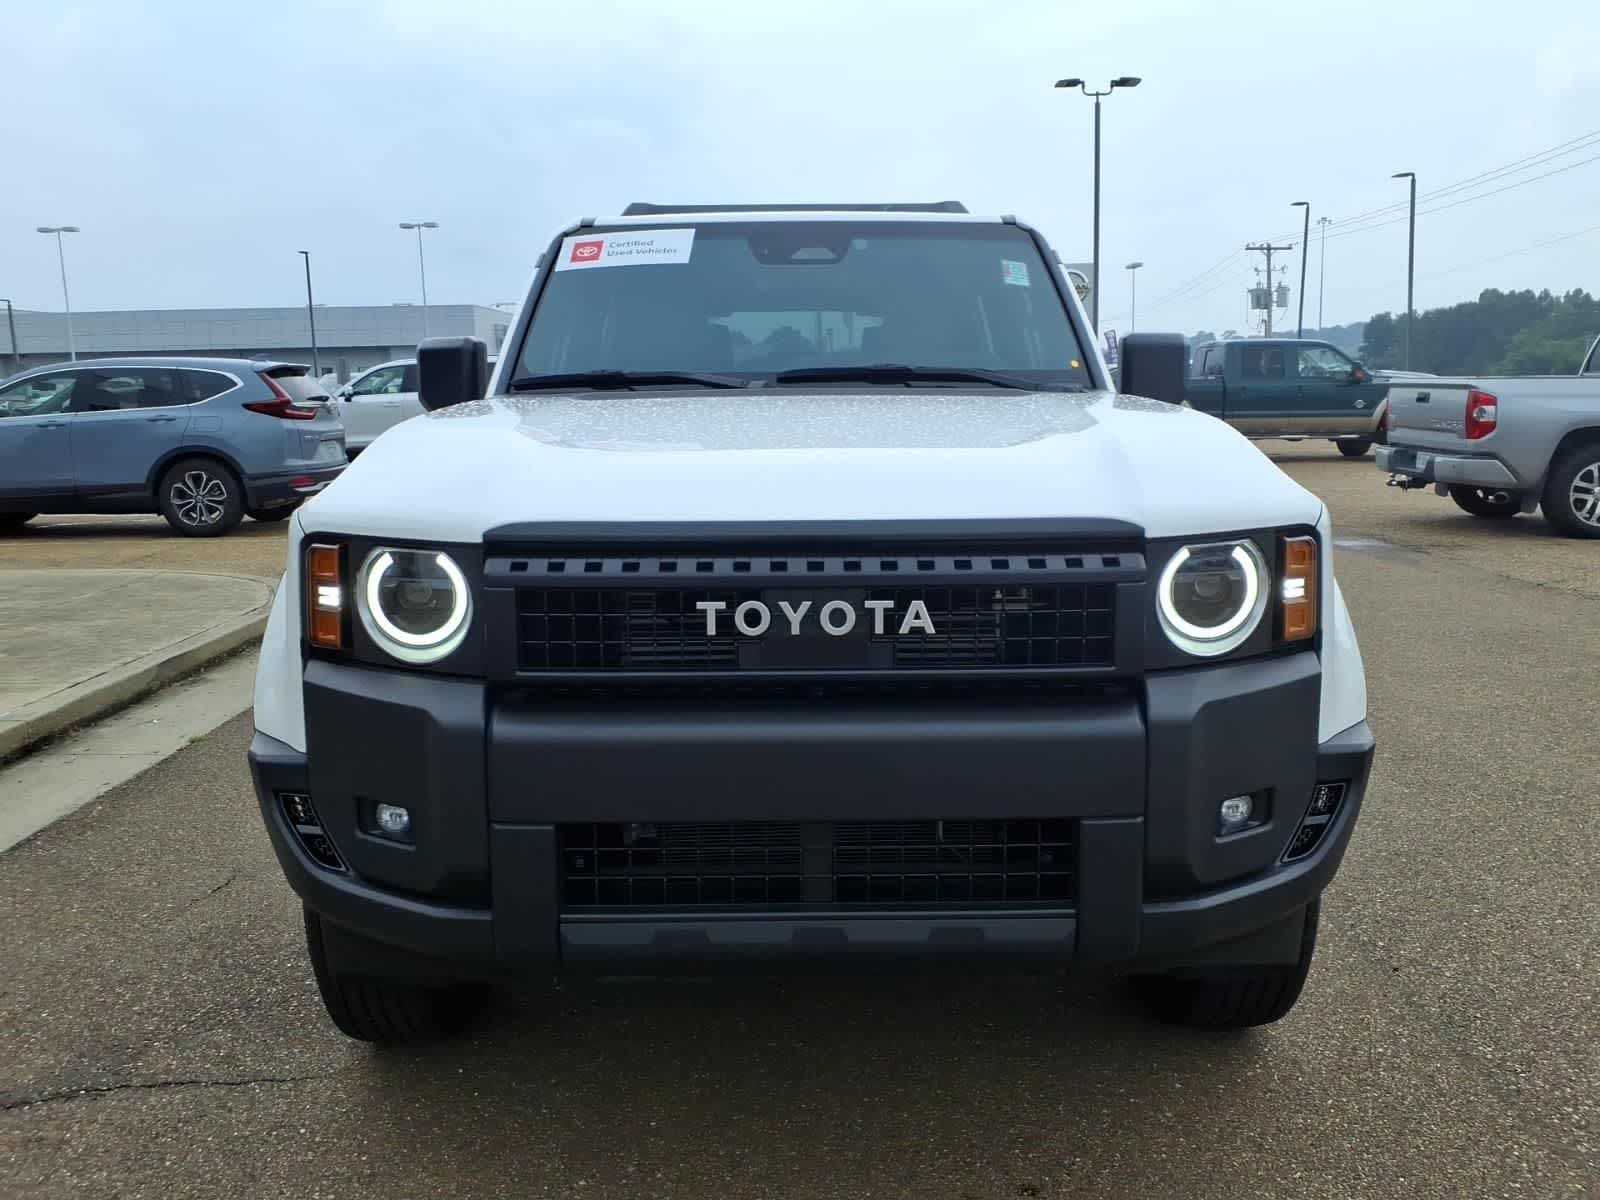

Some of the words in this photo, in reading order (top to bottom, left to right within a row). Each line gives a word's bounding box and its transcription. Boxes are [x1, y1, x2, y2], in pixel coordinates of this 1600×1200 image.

[609, 239, 654, 248] Certified
[607, 249, 633, 257] Used
[636, 247, 678, 256] Vehicles
[696, 600, 936, 636] TOYOTA
